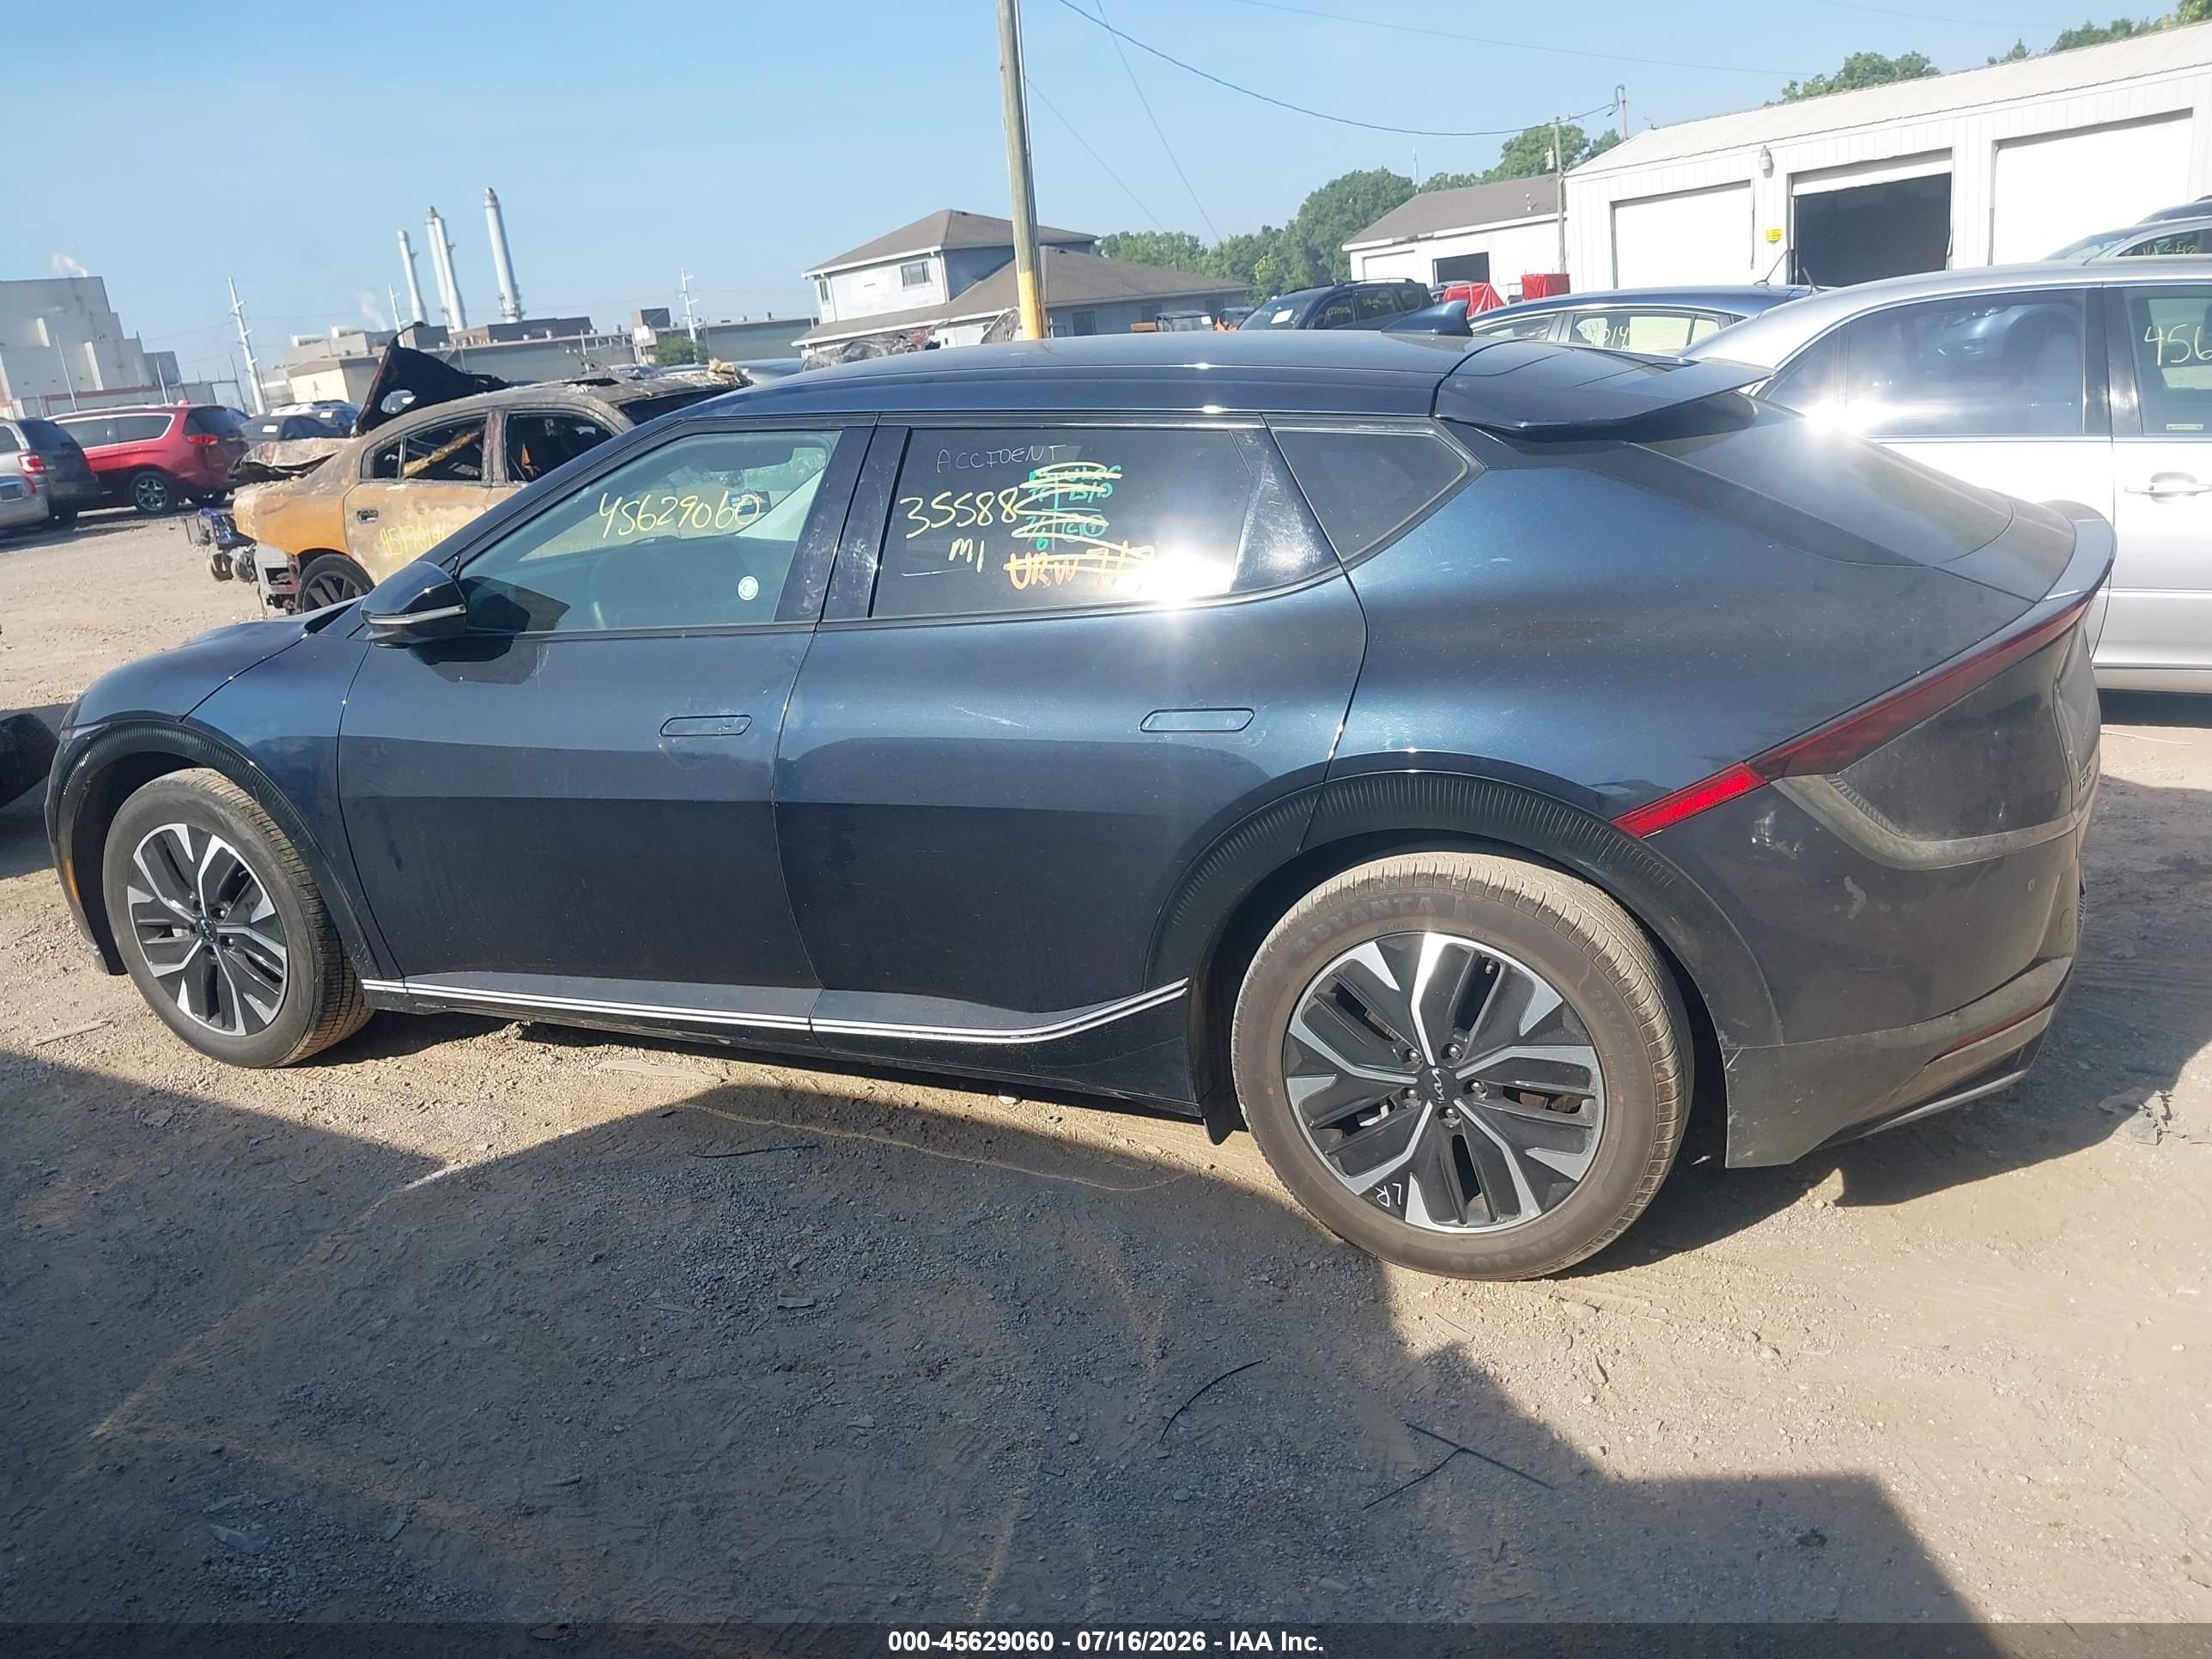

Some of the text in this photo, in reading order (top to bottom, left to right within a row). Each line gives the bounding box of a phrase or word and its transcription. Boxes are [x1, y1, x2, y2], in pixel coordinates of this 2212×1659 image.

[2144, 323, 2212, 367] 456
[936, 444, 1067, 473] ACCIDENT
[599, 490, 760, 539] 45629060
[899, 486, 1020, 539] 35588
[1297, 896, 1437, 957] ADVANTA
[1374, 1182, 1402, 1208] LR
